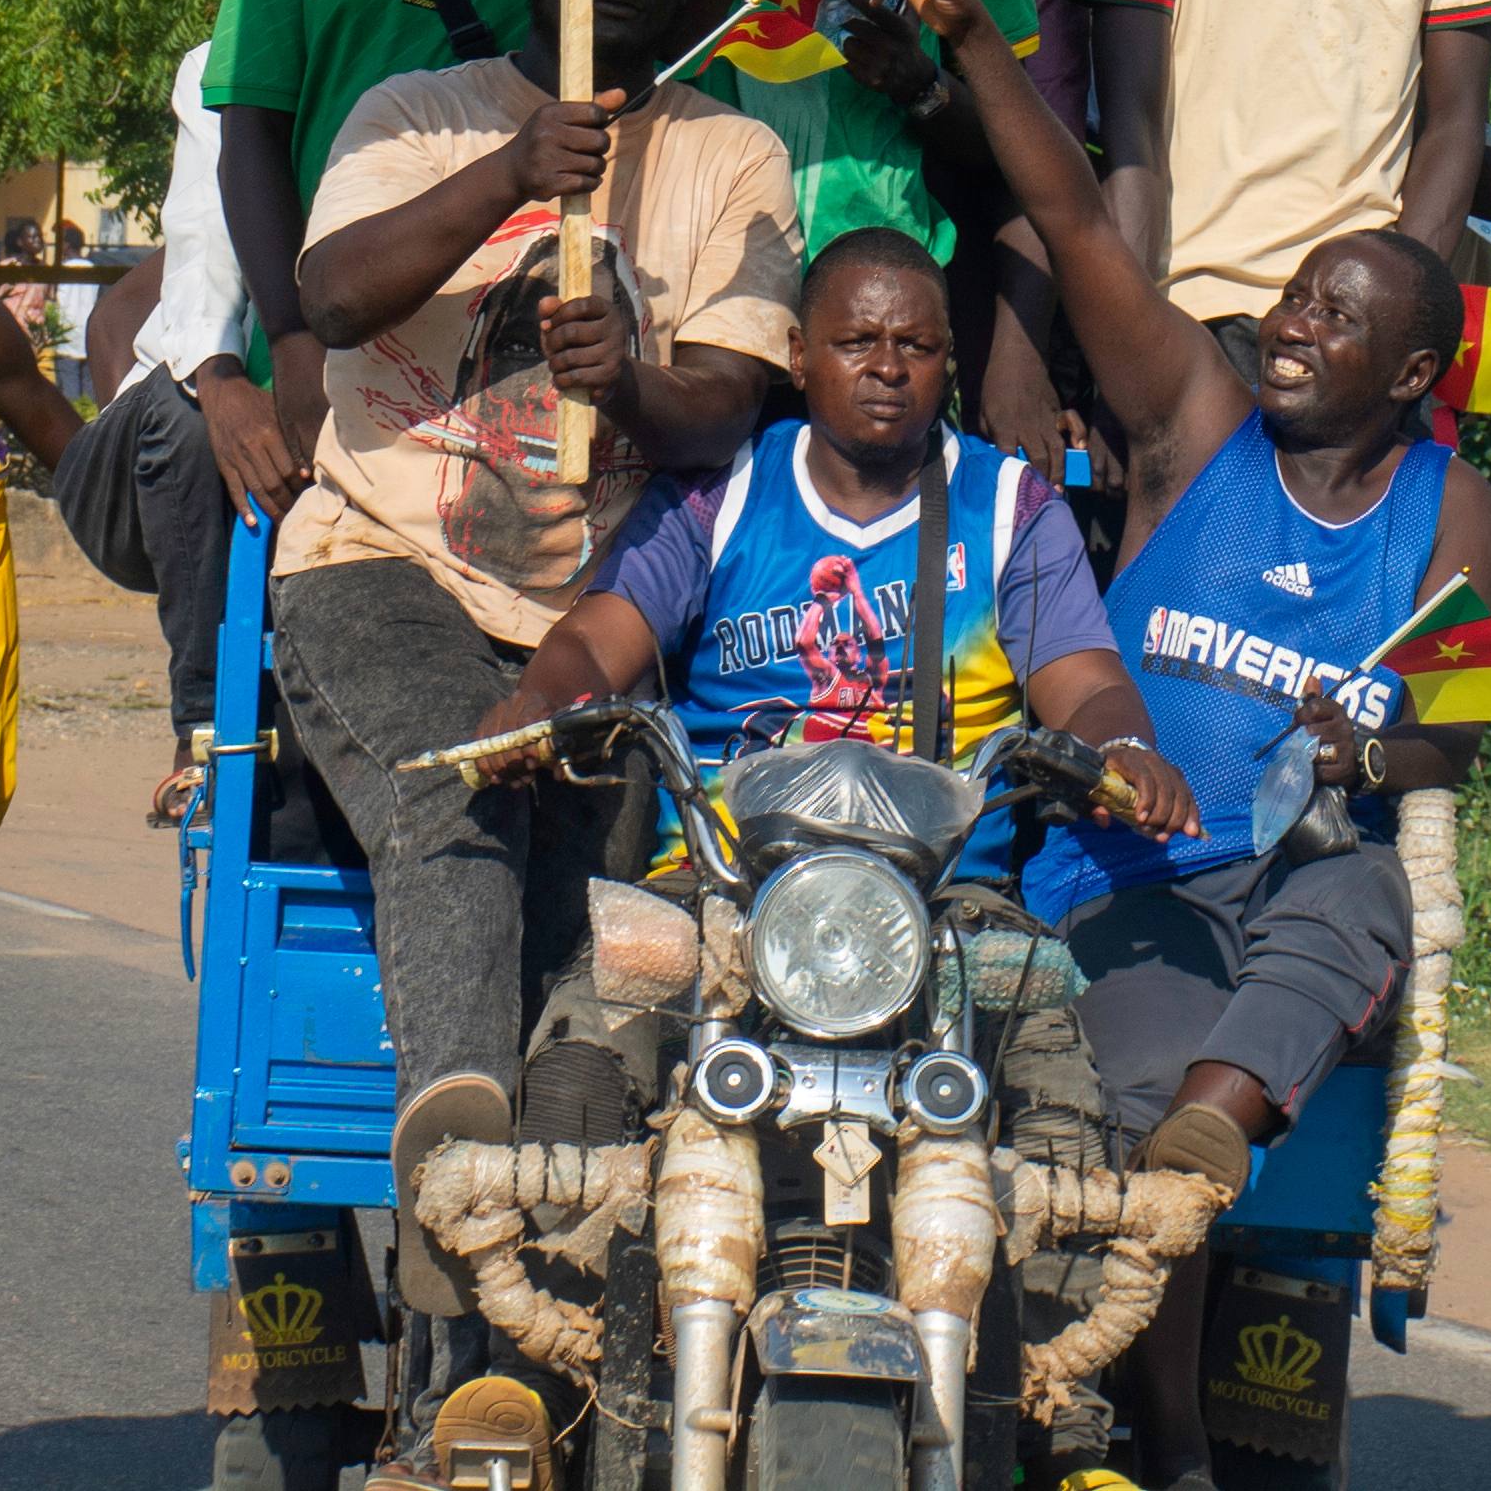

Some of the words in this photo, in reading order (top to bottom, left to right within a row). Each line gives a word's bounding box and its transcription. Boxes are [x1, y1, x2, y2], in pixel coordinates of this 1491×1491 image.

[1262, 569, 1316, 598] adidas
[221, 1345, 347, 1372] MOTORCYCLE
[1208, 1378, 1332, 1421] MOTORCYCLE
